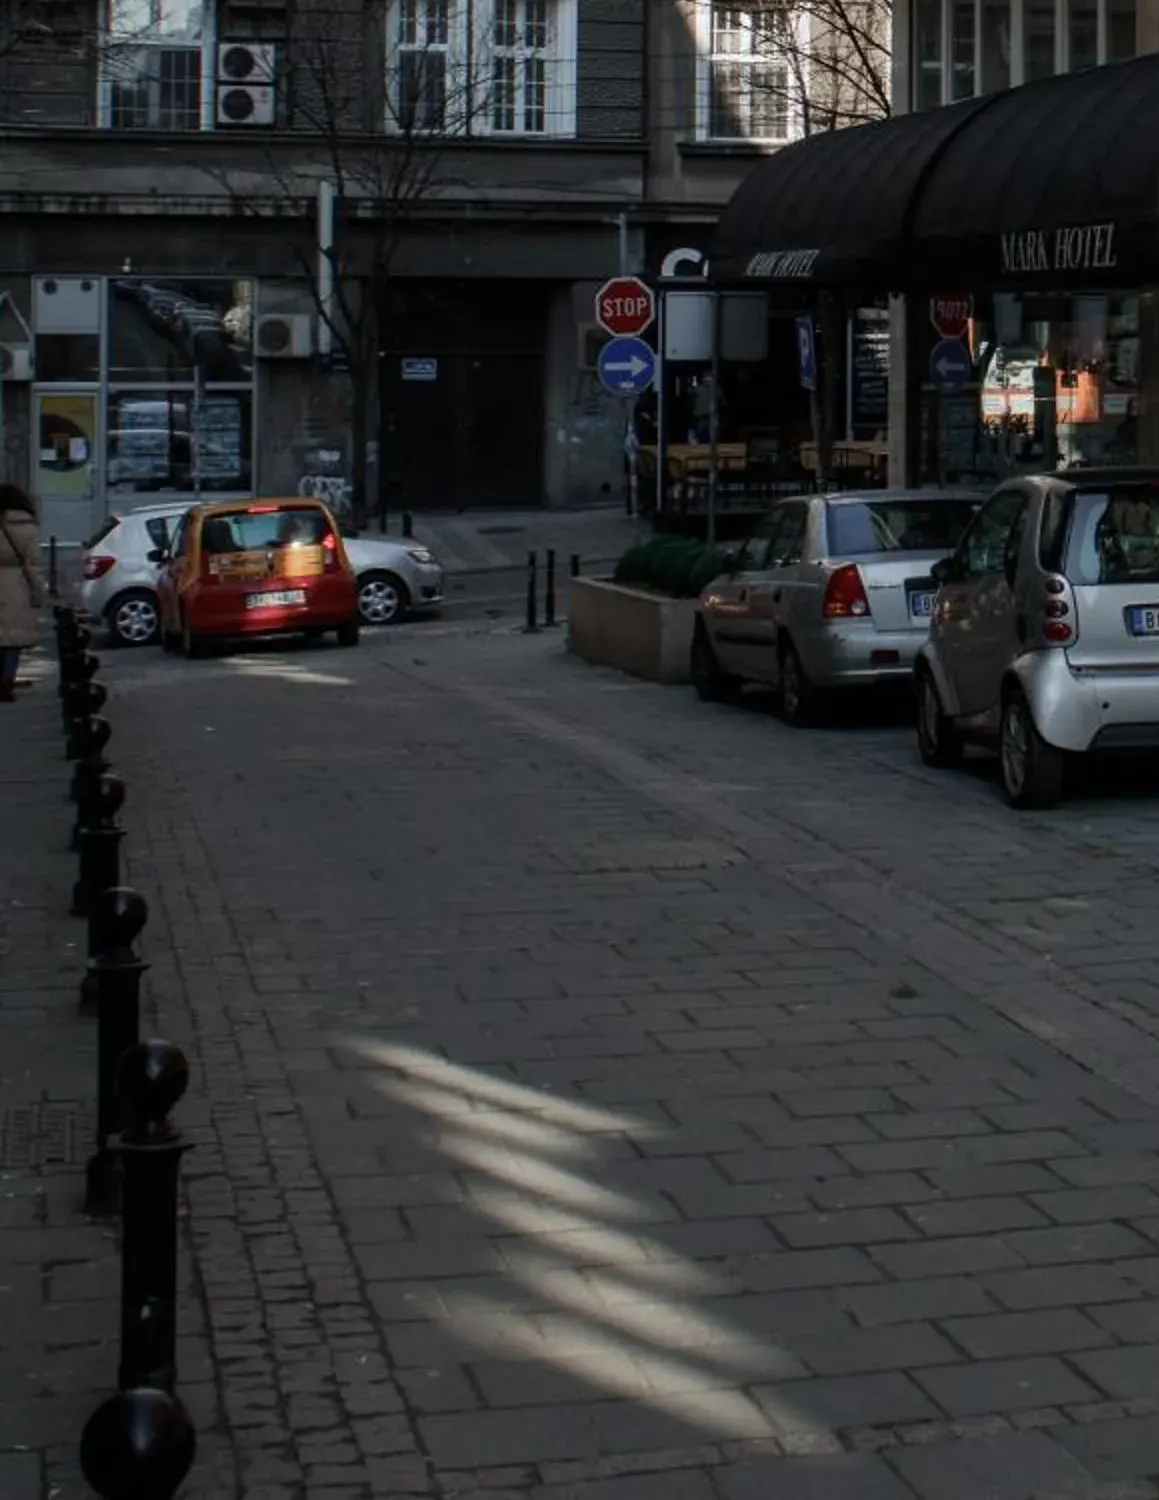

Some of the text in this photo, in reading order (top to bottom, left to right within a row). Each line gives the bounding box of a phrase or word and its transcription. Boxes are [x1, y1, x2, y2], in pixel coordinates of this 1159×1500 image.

[1000, 221, 1118, 274] MARK HOTEL
[602, 296, 648, 319] STOP
